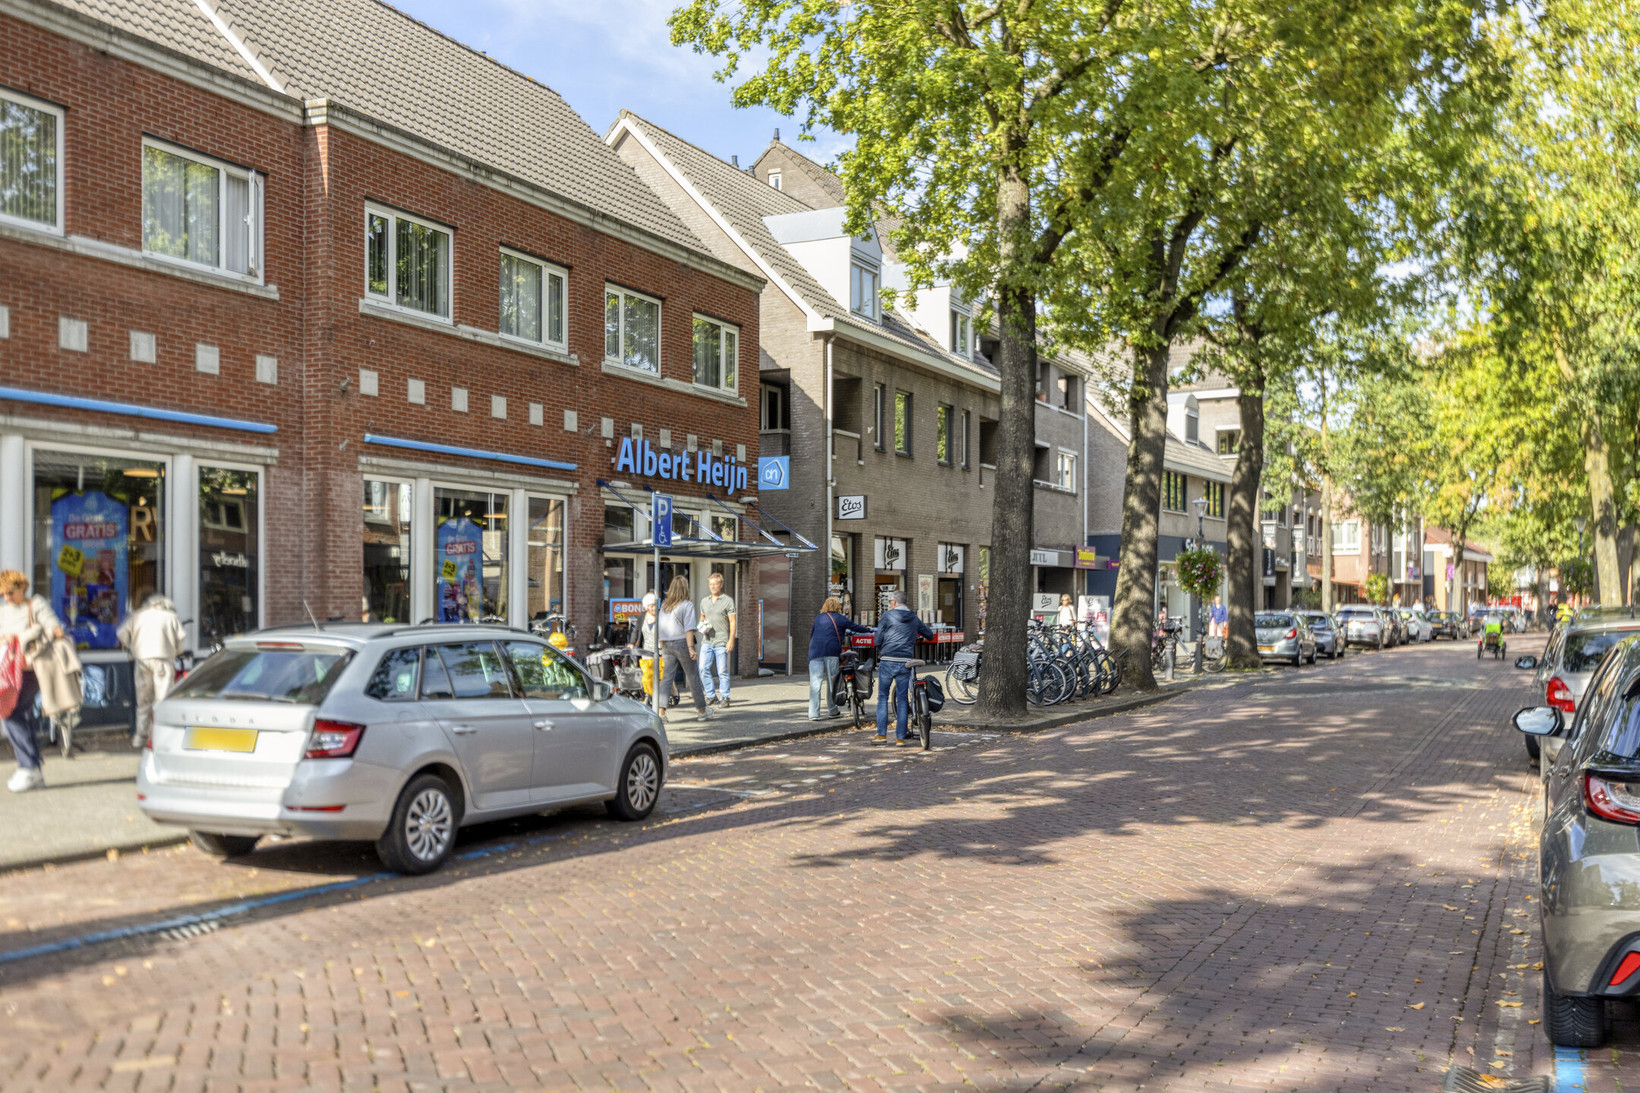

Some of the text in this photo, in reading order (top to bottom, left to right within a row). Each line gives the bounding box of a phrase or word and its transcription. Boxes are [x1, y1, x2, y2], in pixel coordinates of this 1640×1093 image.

[616, 437, 748, 495] Albert Heijn
[658, 499, 668, 525] P
[841, 498, 862, 513] Etos
[66, 524, 115, 539] GRATIS
[446, 542, 475, 555] GRATIS
[622, 604, 646, 613] BON
